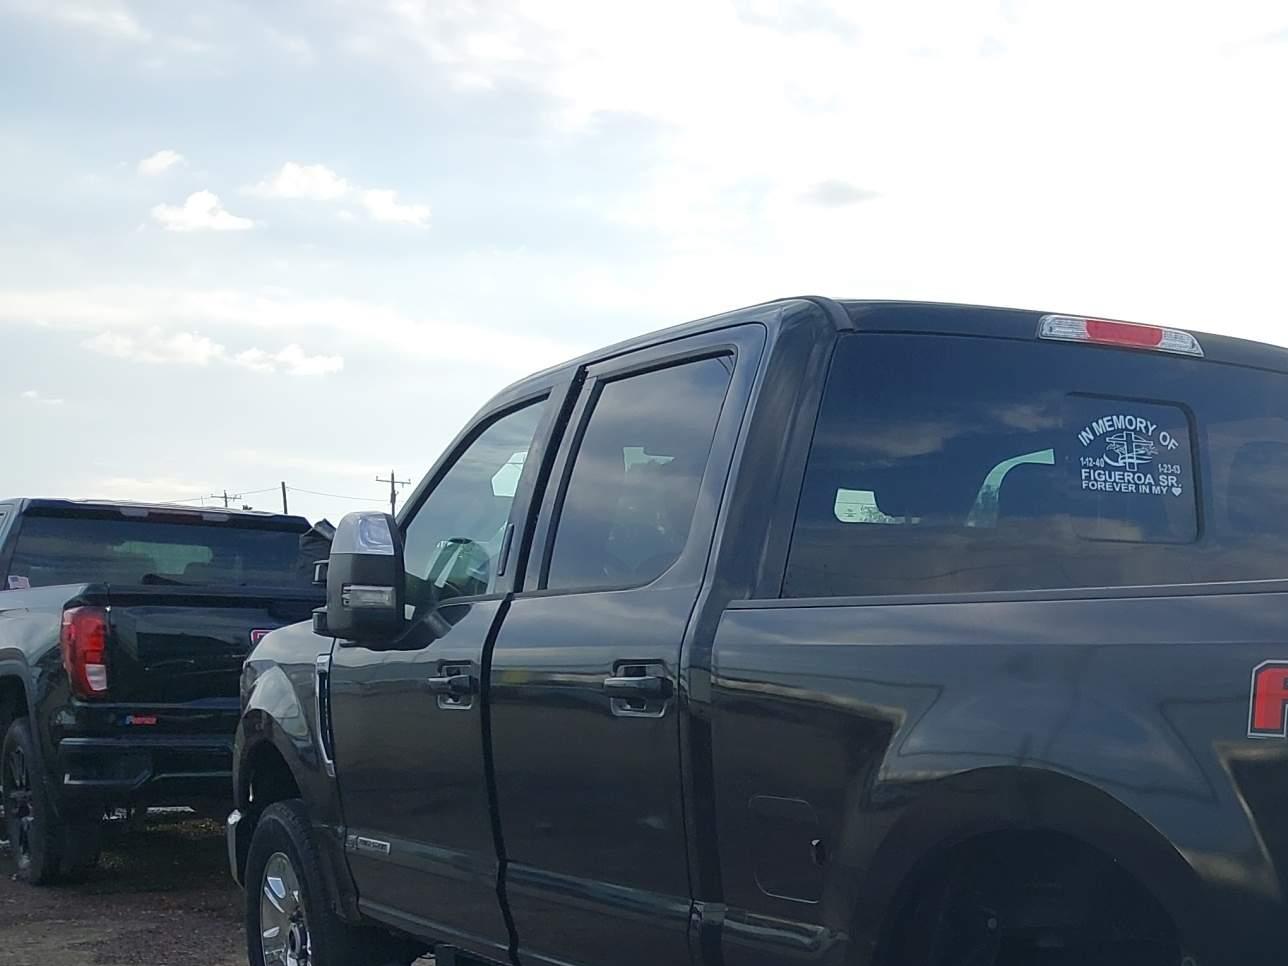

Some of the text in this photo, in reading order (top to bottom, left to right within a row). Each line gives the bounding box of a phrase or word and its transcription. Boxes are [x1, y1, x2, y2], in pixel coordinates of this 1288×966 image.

[1078, 415, 1179, 450] IN MEMORY OF
[1081, 469, 1182, 487] FIGUEROA SR.
[1082, 480, 1168, 495] FOREVER IN MY
